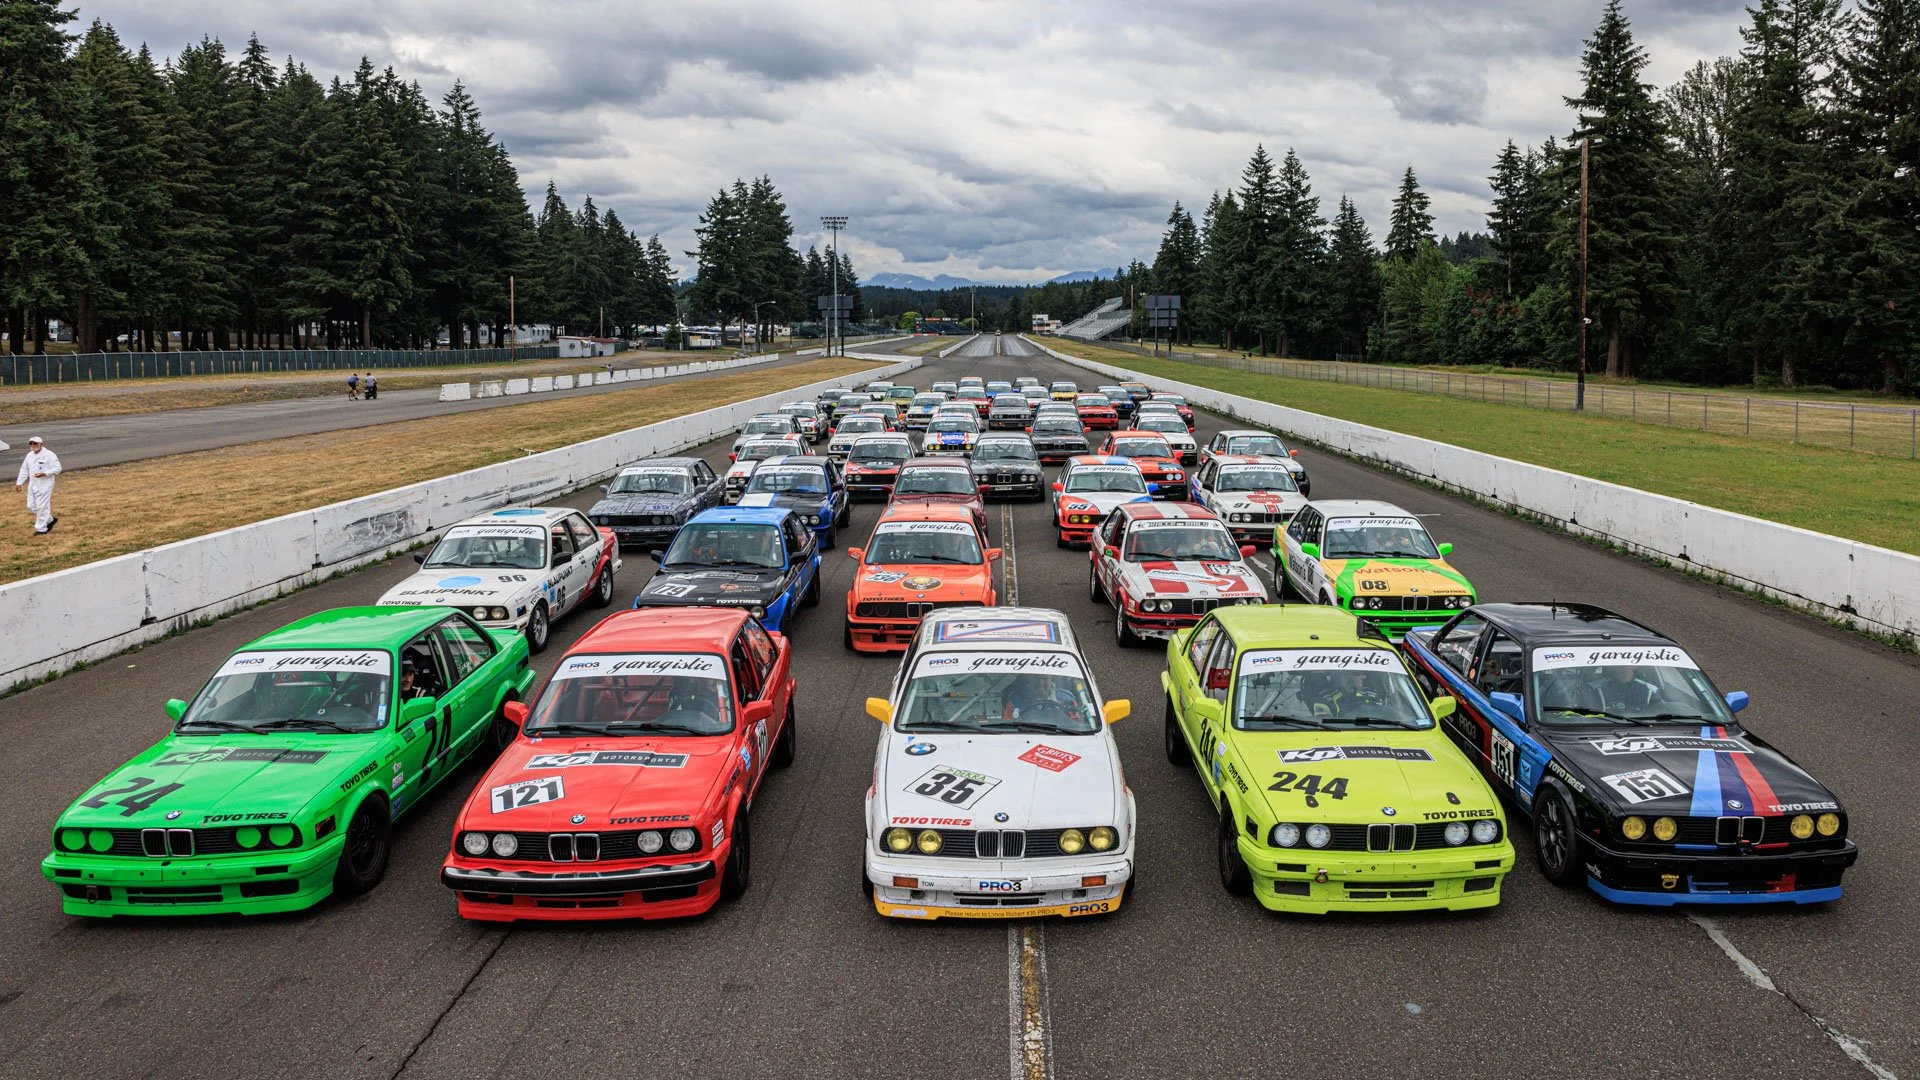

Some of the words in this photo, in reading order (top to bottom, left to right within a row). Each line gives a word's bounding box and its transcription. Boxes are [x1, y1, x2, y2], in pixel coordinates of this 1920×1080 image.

[909, 523, 967, 532] garagistic
[1357, 517, 1414, 527] garagistic
[476, 527, 537, 536] garagistic
[1354, 566, 1440, 575] Watson's
[498, 575, 528, 583] 96
[1361, 580, 1388, 590] 08
[398, 588, 499, 596] BLAUPUNKT
[234, 658, 265, 666] PRO3
[268, 653, 379, 671] garagistic
[929, 658, 959, 667] PRO3
[967, 655, 1069, 671] garagistic
[1252, 656, 1283, 665] PRO3
[1293, 652, 1390, 669] garagistic
[1544, 652, 1575, 661] PRO3
[1587, 649, 1680, 665] garagistic
[569, 661, 600, 670] PRO3
[606, 657, 713, 675] garagistic
[1458, 713, 1477, 740] PRO3
[1666, 740, 1738, 749] MOTORSPORTS
[235, 752, 315, 760] MOTORSPORTS
[602, 755, 677, 764] MOTORSPORTS
[1350, 749, 1423, 758] MOTORSPORTS
[1492, 736, 1515, 789] 151
[340, 774, 360, 792] TOYO
[358, 760, 378, 779] TIRES
[952, 769, 986, 782] DEKRA
[1227, 762, 1239, 779] TOYO
[1235, 776, 1249, 794] TIRES
[1549, 760, 1567, 778] TOYO
[1564, 774, 1586, 793] TIRES
[915, 773, 985, 804] 35
[1267, 771, 1349, 800] 244
[1617, 774, 1677, 800] 151
[80, 777, 185, 817] 24
[495, 782, 559, 811] 121
[1769, 804, 1804, 813] TOYO
[1805, 802, 1838, 811] TIRES
[203, 813, 242, 824] TOYO
[245, 812, 289, 820] TIRES
[609, 816, 648, 825] TOYO
[649, 814, 691, 823] TIRES
[892, 816, 929, 825] TOYO
[930, 818, 972, 826] TIRES
[1422, 810, 1457, 821] TOYO
[1458, 809, 1495, 818] TIRES
[979, 880, 1022, 892] PRO3
[1069, 902, 1109, 916] PRO3
